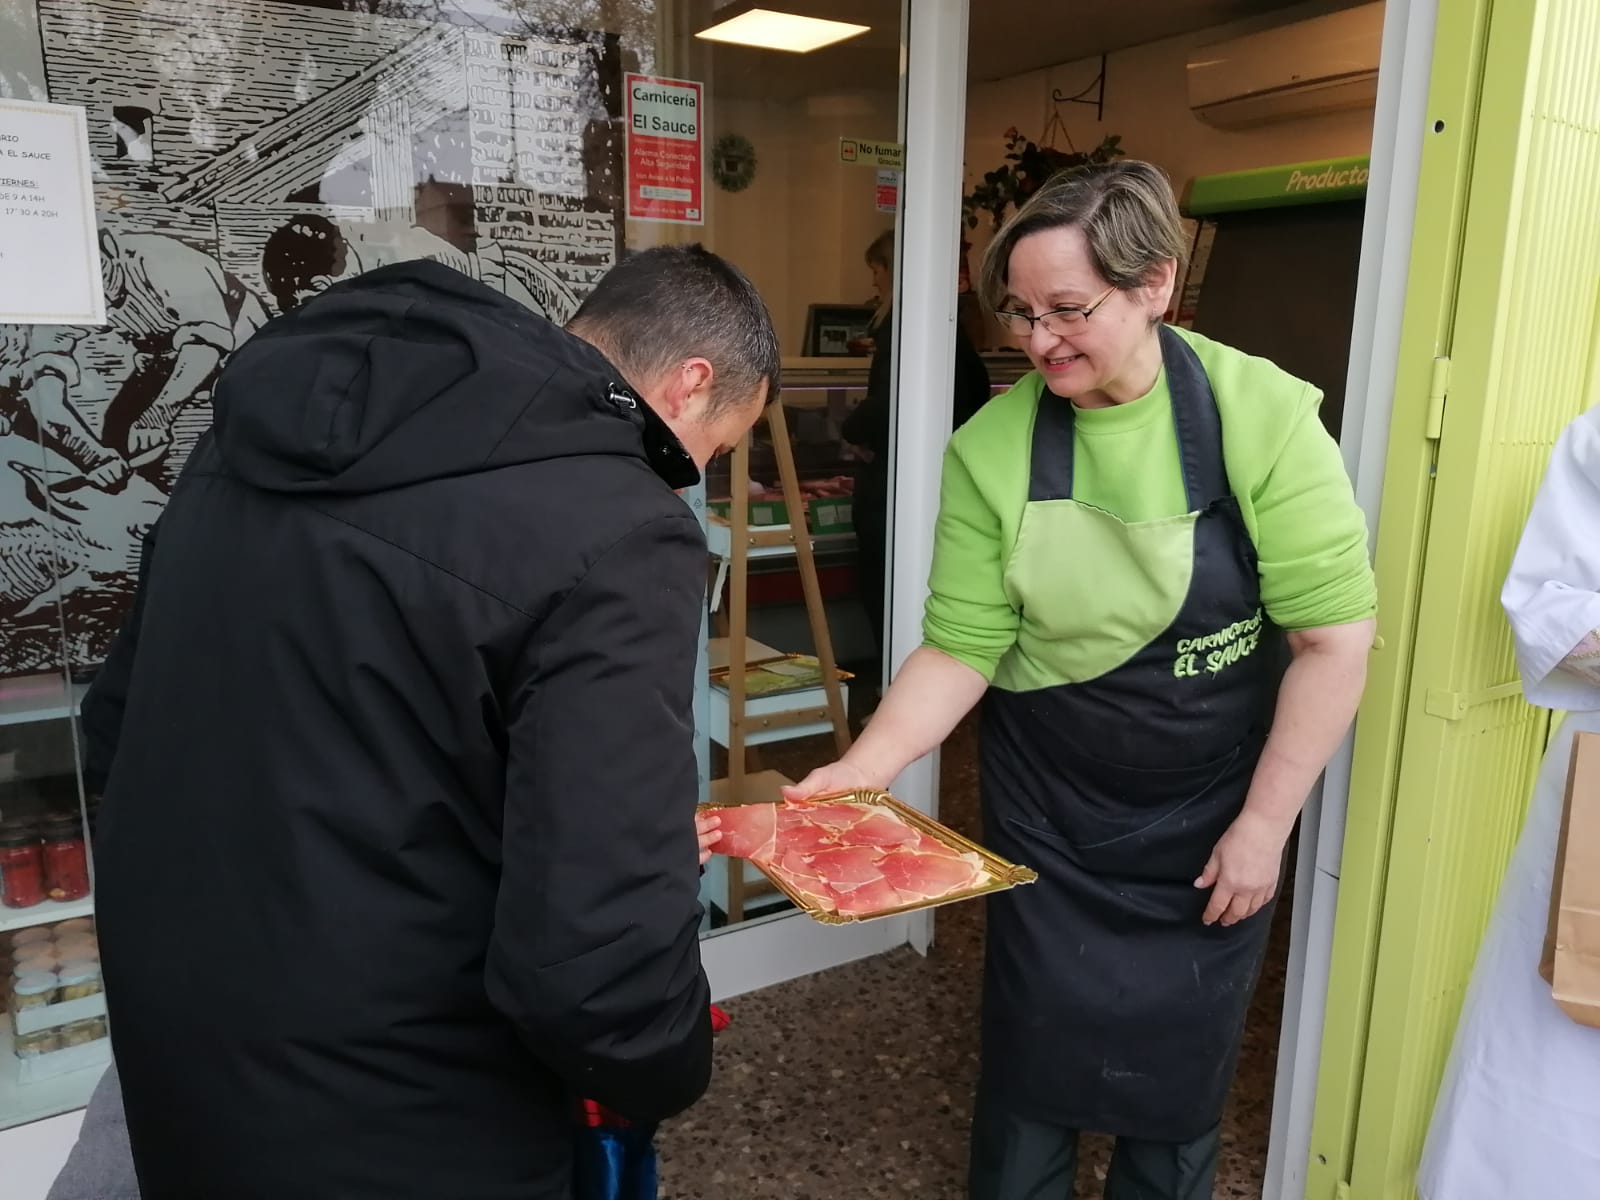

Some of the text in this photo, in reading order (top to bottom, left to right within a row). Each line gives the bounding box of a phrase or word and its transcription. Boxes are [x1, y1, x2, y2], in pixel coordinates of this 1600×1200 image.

[633, 87, 696, 108] Carnicería
[633, 114, 696, 135] El Sauce
[0, 134, 19, 143] RIO
[22, 151, 52, 161] SAUCE
[859, 143, 902, 157] No fumar
[1285, 164, 1370, 193] Producto
[1174, 653, 1200, 678] EL
